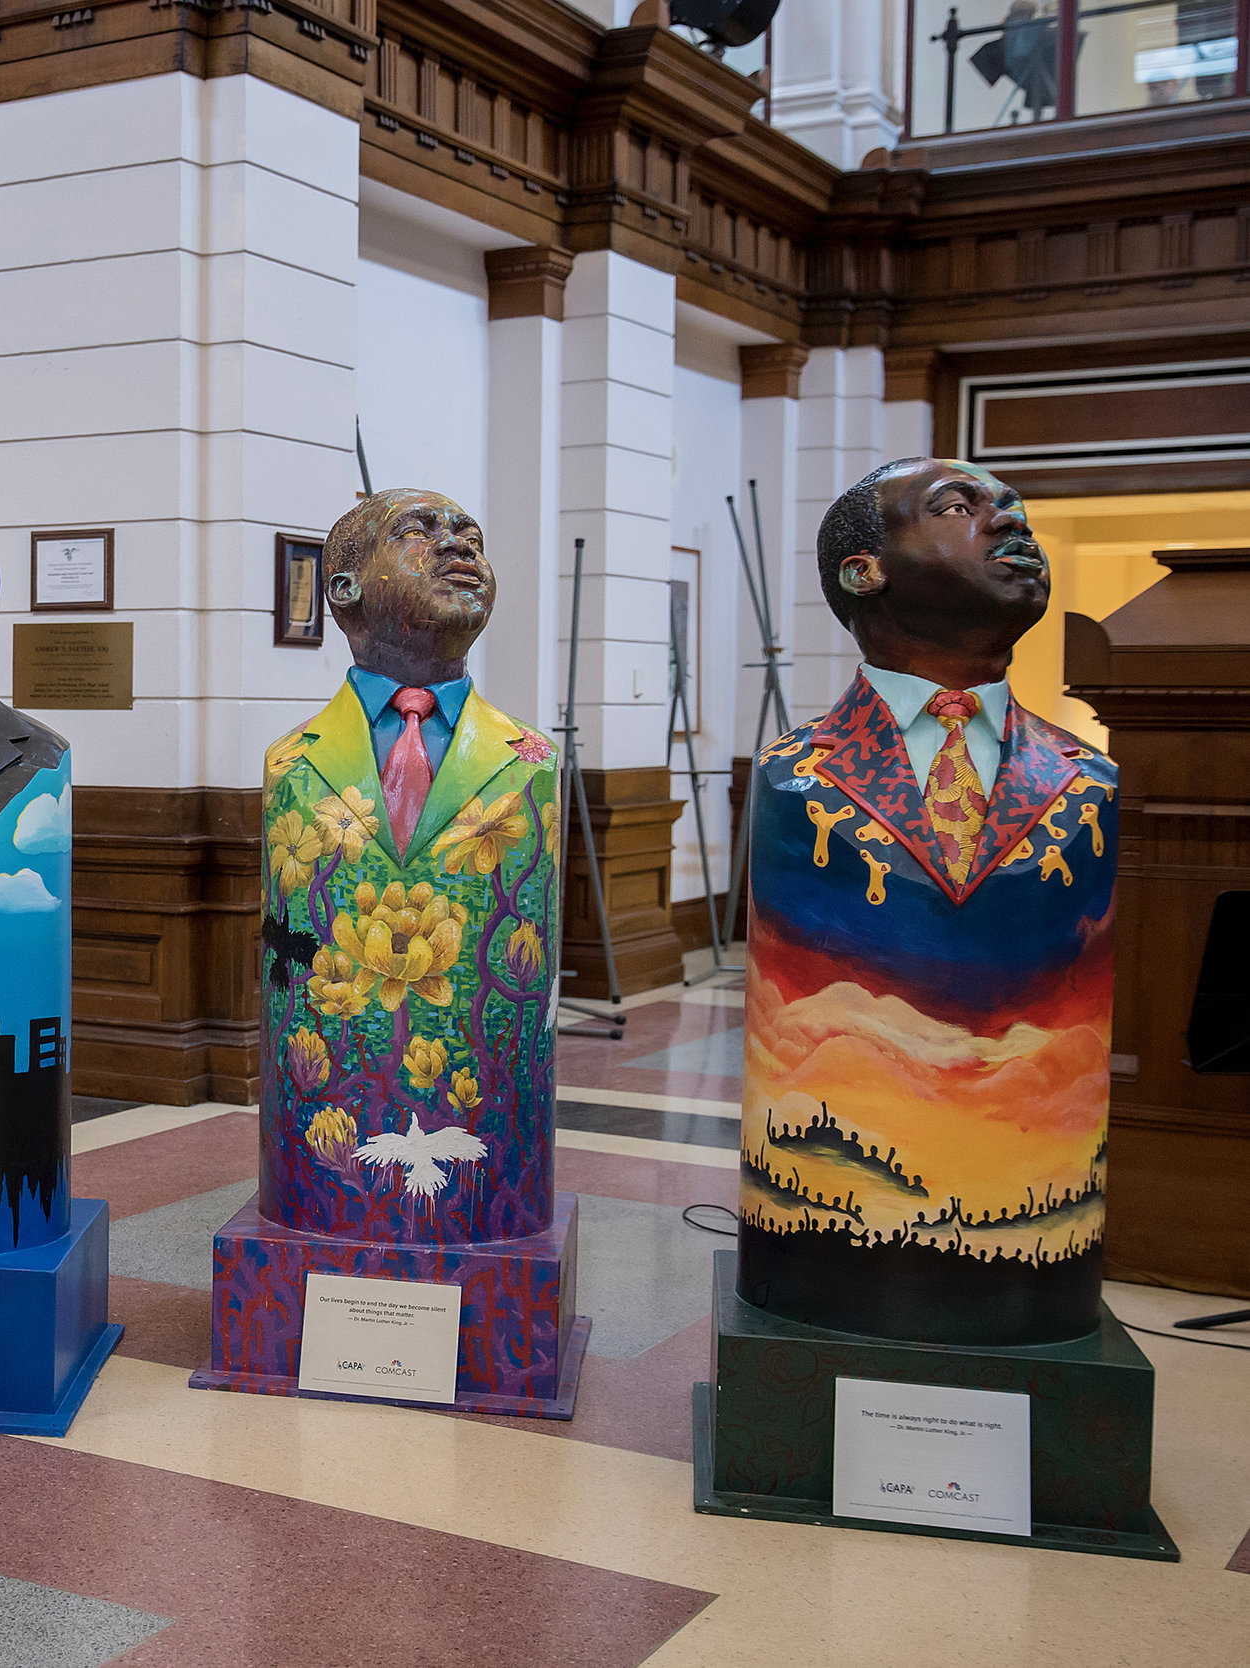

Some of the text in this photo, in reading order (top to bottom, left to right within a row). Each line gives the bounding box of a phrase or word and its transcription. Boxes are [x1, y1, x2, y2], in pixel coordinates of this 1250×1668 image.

[343, 1298, 360, 1306] begin
[387, 1302, 399, 1310] day
[408, 1304, 430, 1312] become
[365, 1308, 383, 1317] things
[395, 1311, 415, 1319] matter.
[374, 1366, 417, 1377] COMCAST
[861, 1410, 874, 1418] The
[874, 1412, 891, 1420] time
[898, 1414, 922, 1422] always
[922, 1417, 940, 1425] right
[984, 1422, 1004, 1431] right.
[927, 1489, 981, 1503] COMCAST
